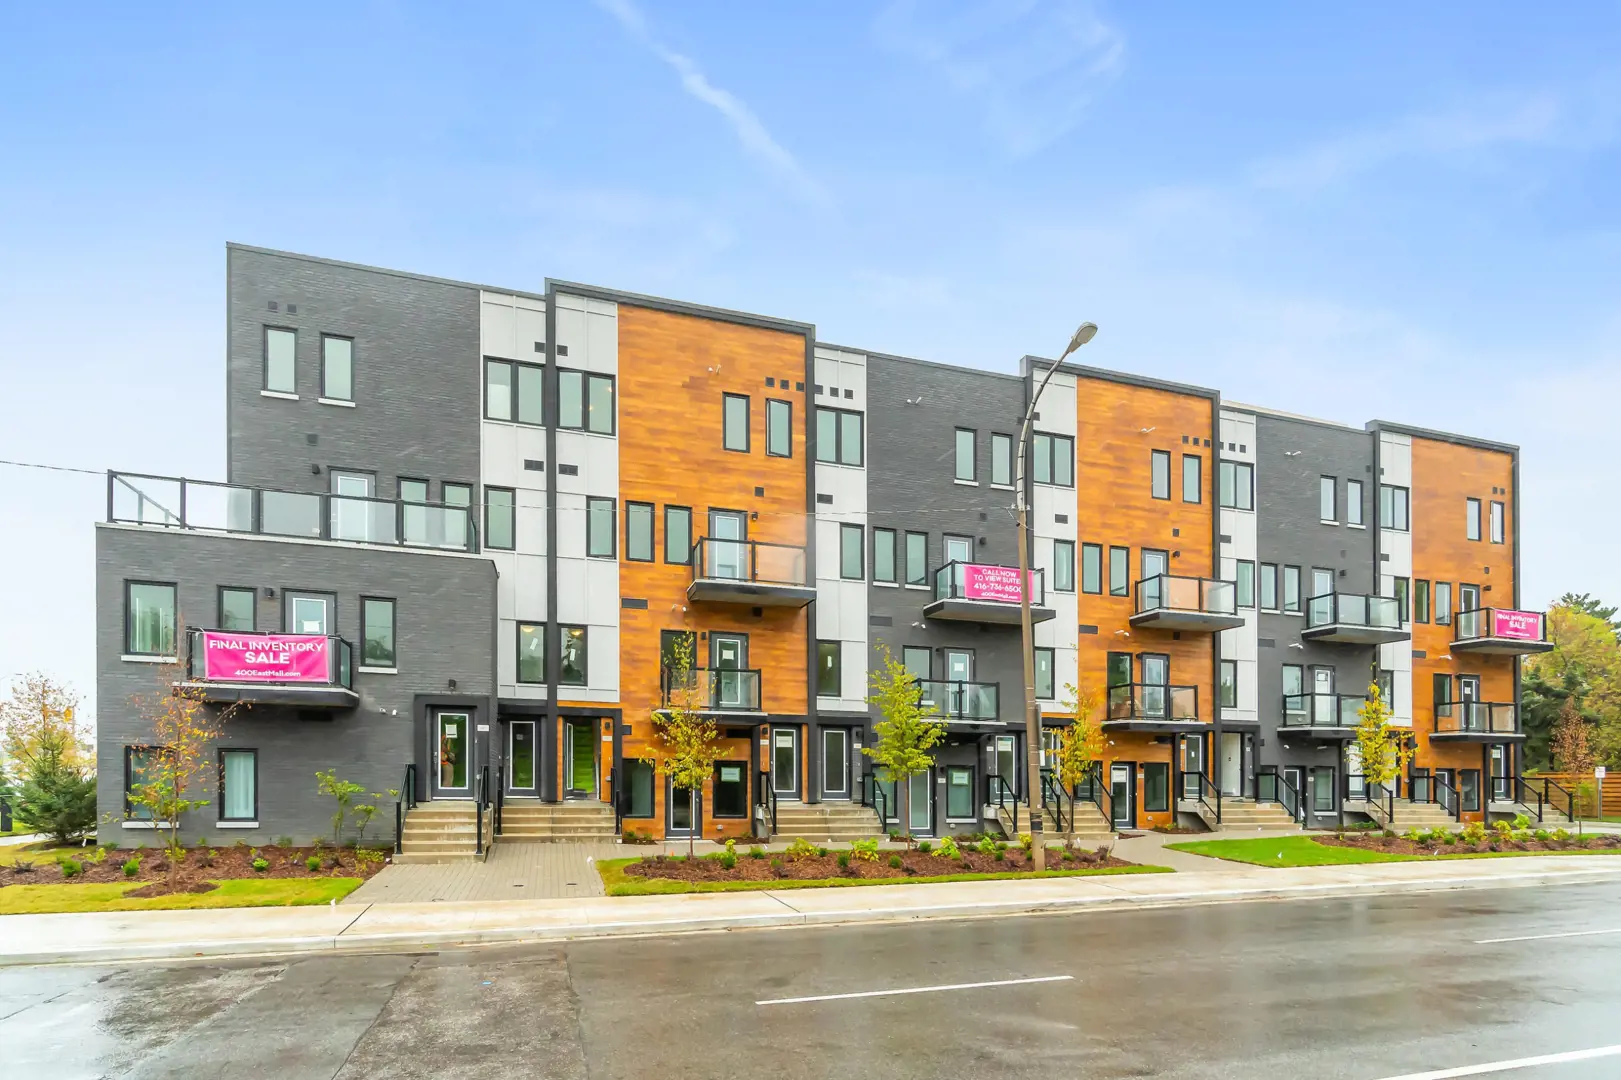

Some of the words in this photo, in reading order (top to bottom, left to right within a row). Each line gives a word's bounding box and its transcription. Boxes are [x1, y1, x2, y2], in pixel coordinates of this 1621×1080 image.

[1509, 621, 1526, 630] SALE
[209, 640, 246, 650] FINAL
[249, 641, 323, 652] INVENTORY
[244, 652, 290, 664] SALE
[234, 669, 301, 677] 400EastMall.com
